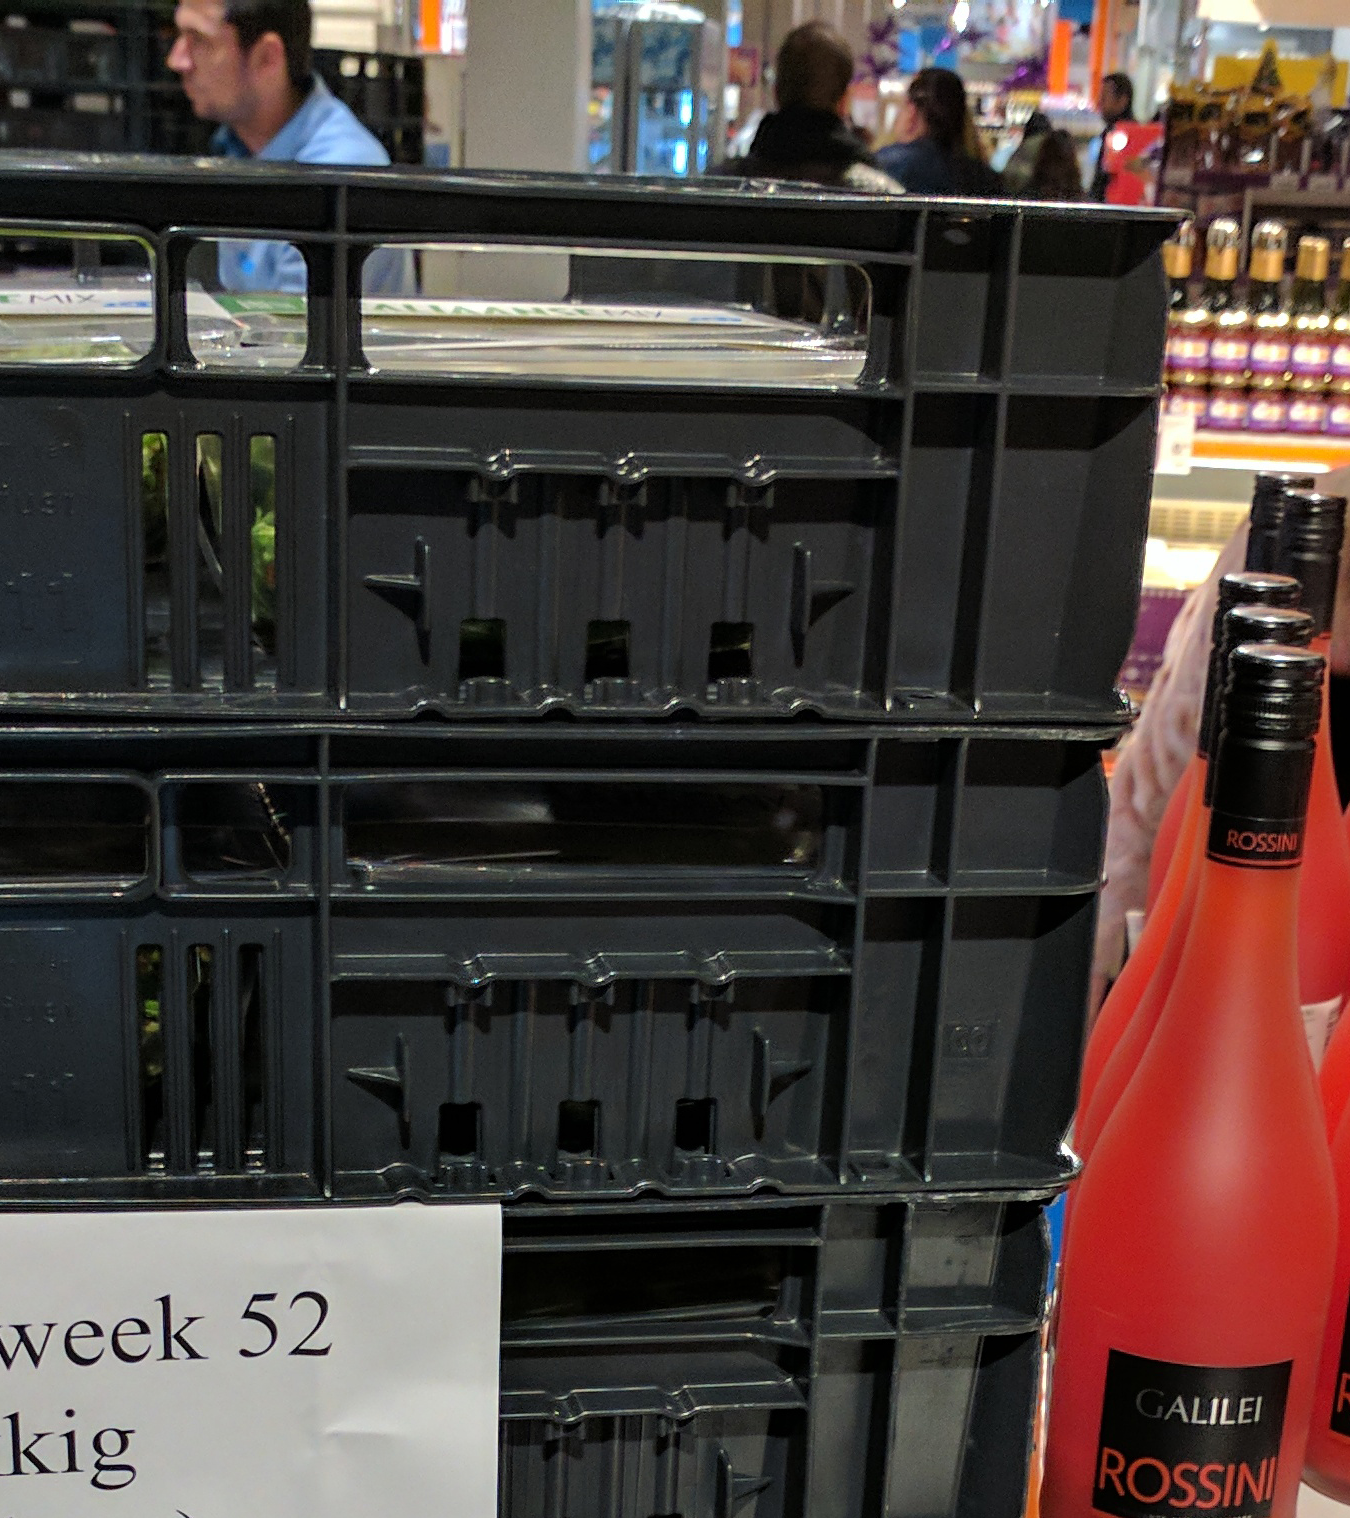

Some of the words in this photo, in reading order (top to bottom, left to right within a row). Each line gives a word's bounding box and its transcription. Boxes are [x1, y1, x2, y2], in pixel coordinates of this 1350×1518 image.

[1227, 829, 1297, 853] ROSSINI
[238, 1291, 334, 1358] 52
[1136, 1388, 1262, 1426] GALILEI
[1099, 1446, 1277, 1509] ROSSINI
